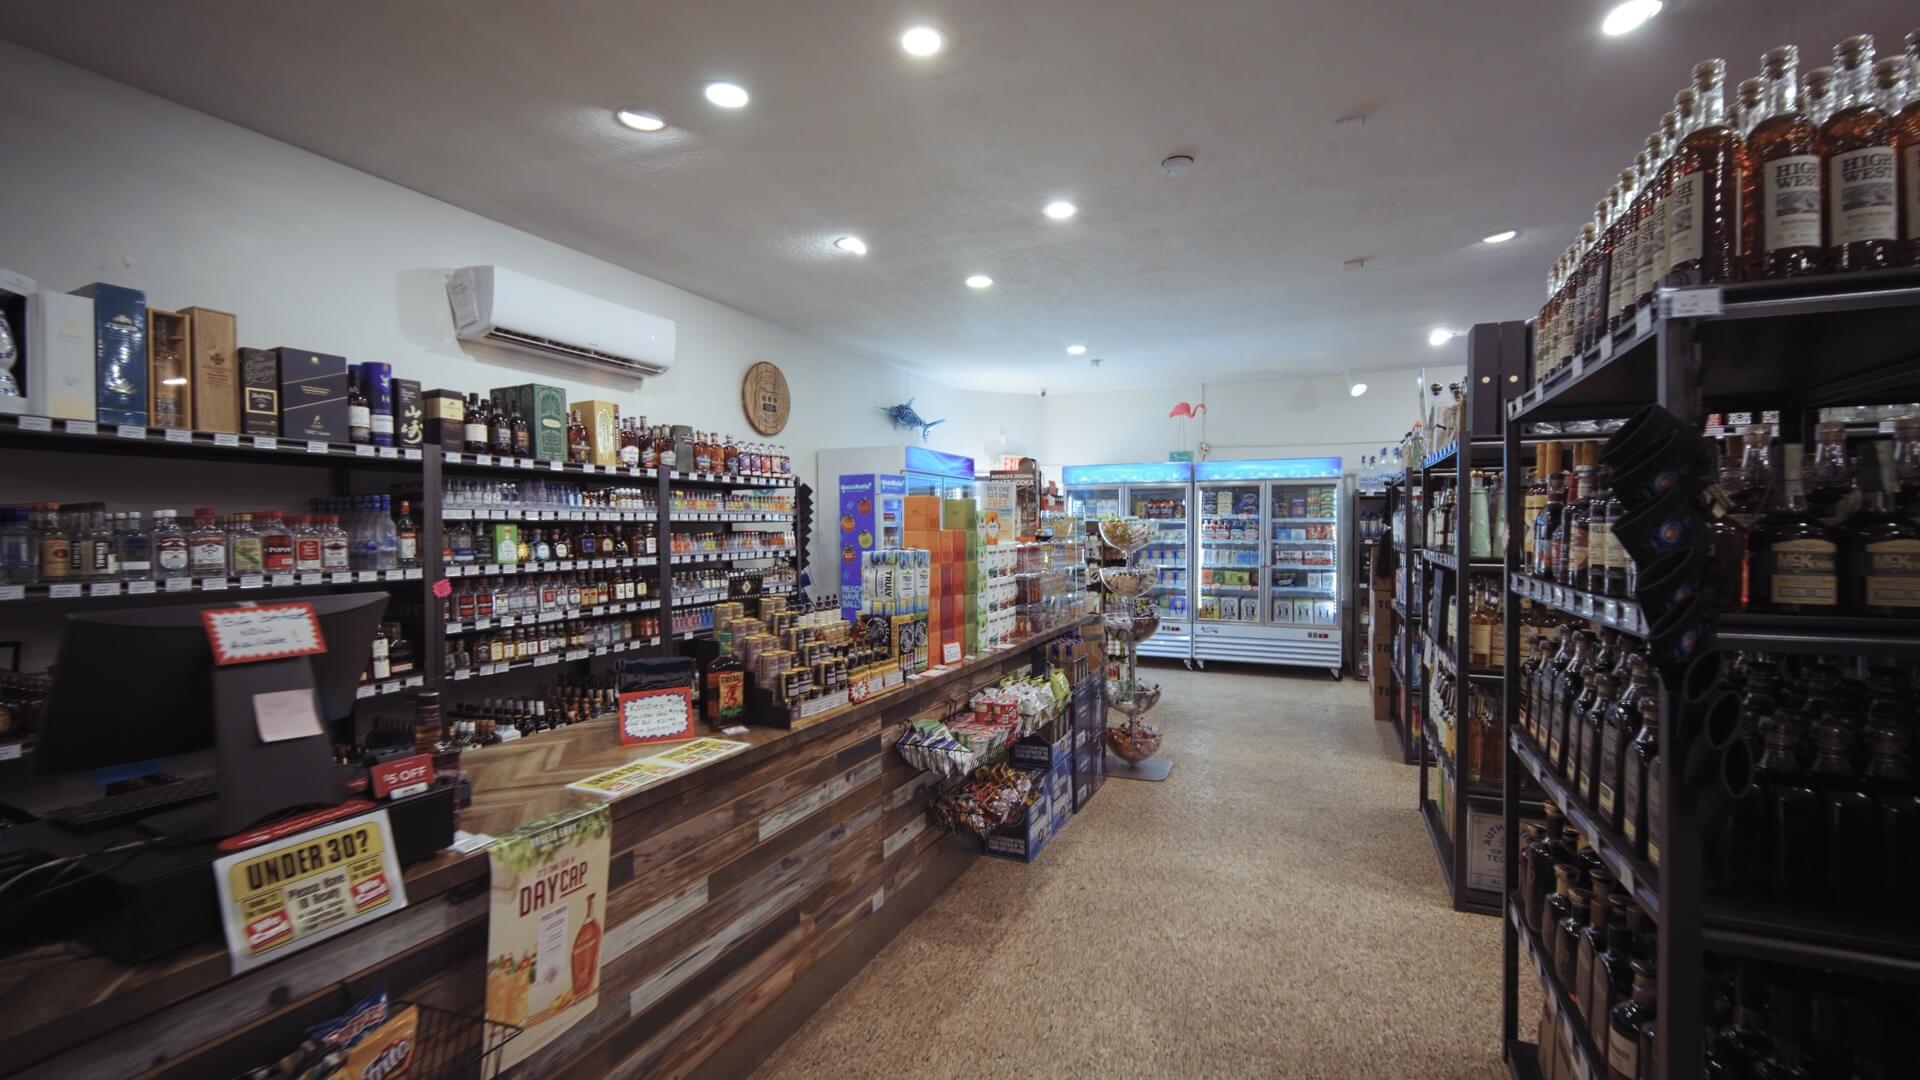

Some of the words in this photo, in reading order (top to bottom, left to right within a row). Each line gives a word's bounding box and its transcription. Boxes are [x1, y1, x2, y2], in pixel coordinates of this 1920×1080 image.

[884, 569, 893, 598] TRULY
[399, 766, 427, 782] OFF
[248, 844, 323, 891] UNDER
[327, 829, 369, 863] 30?
[519, 861, 588, 917] DAYCAP
